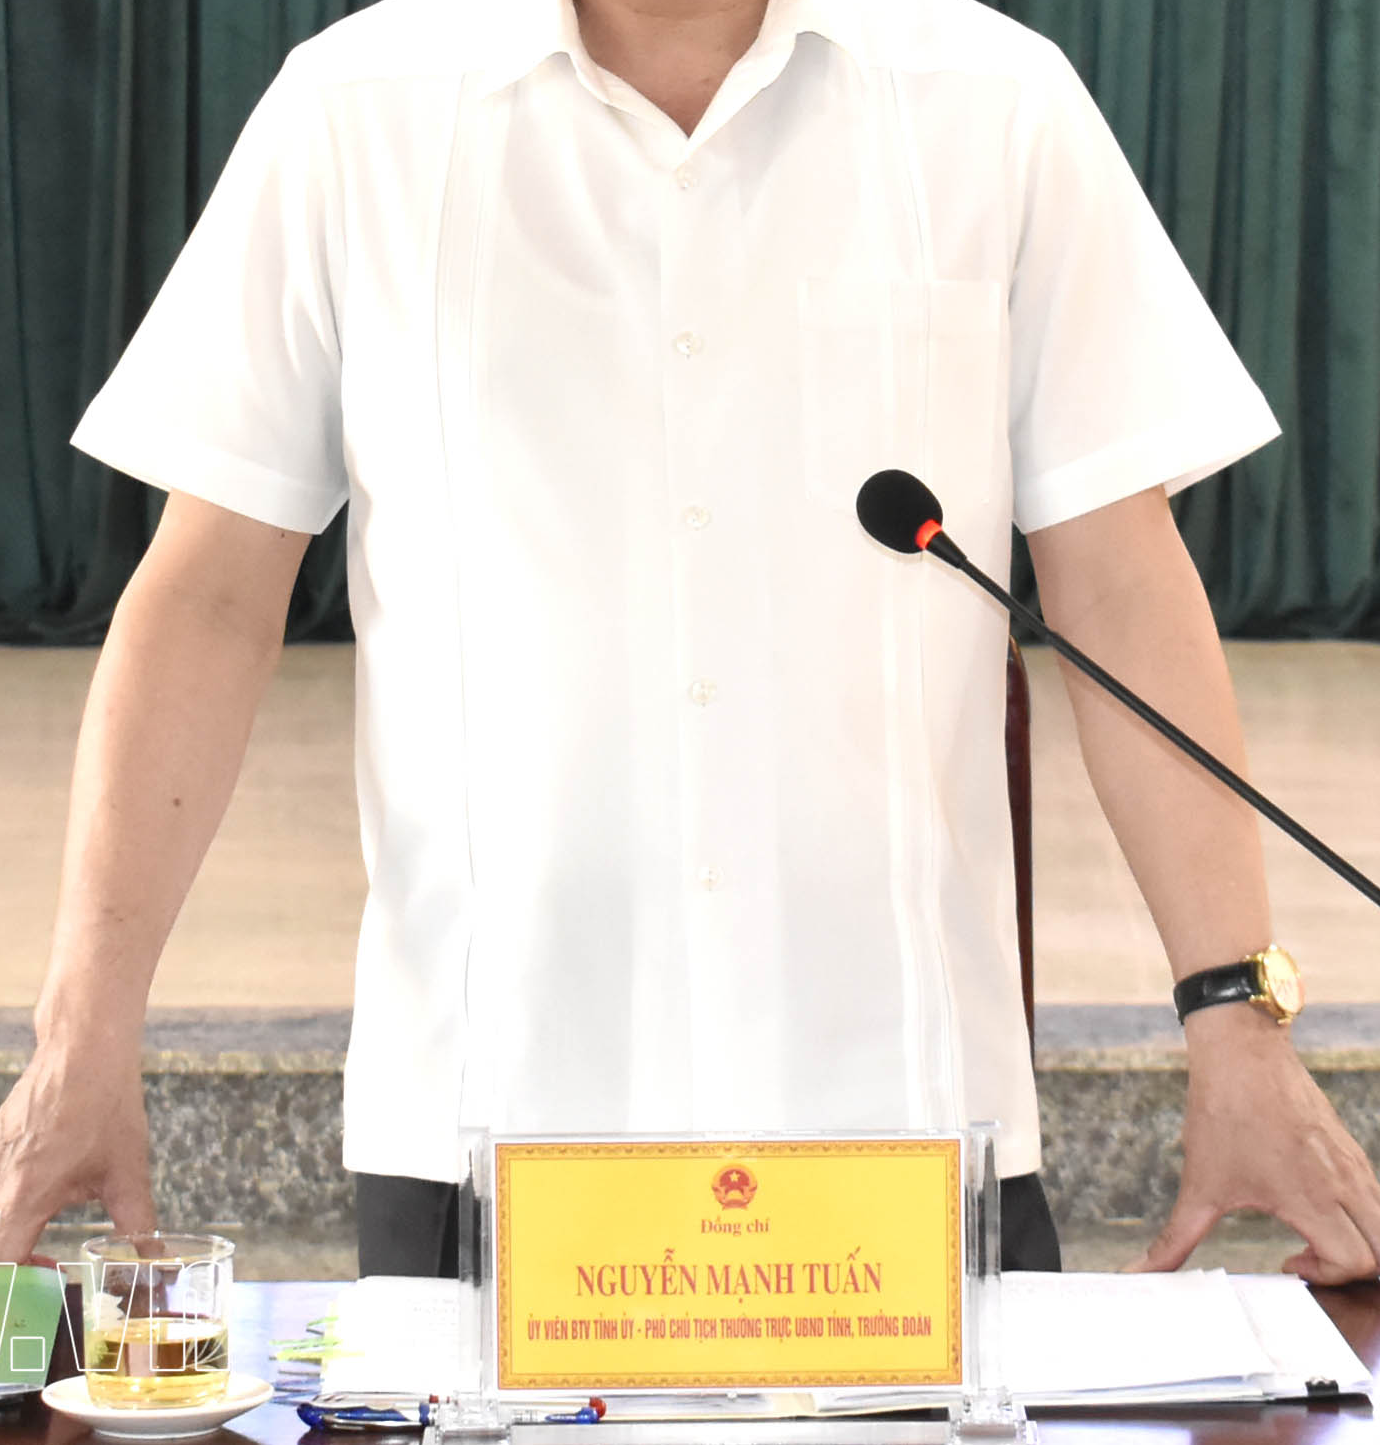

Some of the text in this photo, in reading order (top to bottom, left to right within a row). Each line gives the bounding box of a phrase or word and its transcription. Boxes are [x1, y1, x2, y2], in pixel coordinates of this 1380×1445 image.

[701, 1215, 770, 1237] Đồng chí
[576, 1245, 882, 1304] NGUYỄN MẠNH TUẤN
[544, 1315, 568, 1340] VIÊN
[571, 1319, 591, 1340] BTV
[693, 1317, 717, 1344] TỊCH
[795, 1316, 824, 1338] UBND
